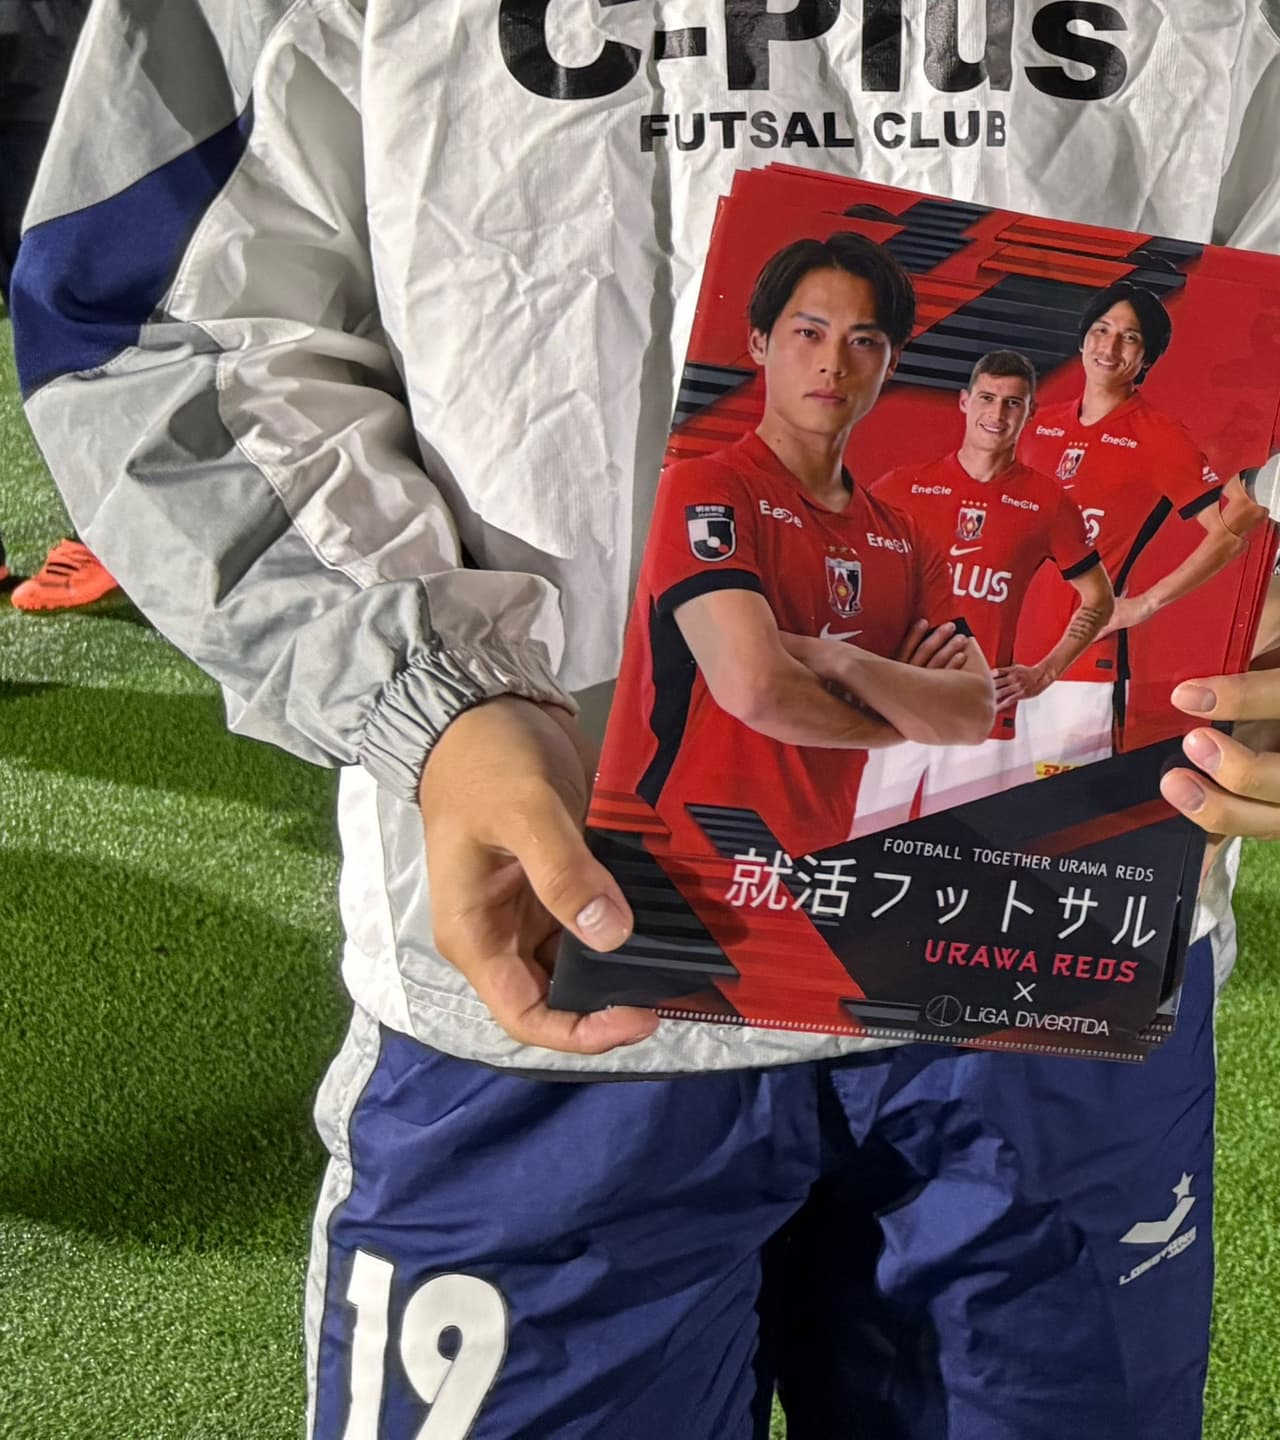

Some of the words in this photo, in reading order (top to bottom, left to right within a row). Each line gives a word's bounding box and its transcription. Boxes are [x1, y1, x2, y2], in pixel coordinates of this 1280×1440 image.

[640, 110, 854, 153] FUTSAL
[873, 111, 1006, 148] CLUB
[947, 561, 1013, 603] LUS
[883, 838, 962, 861] FOOTBALL
[972, 848, 1051, 871] TOGETHER
[1058, 858, 1108, 878] URAWA
[1115, 866, 1155, 883] REDS
[724, 847, 1157, 950] 就活フットサル
[924, 939, 1038, 974] URAWA
[1051, 953, 1140, 984] REDS
[346, 1248, 508, 1440] 19
